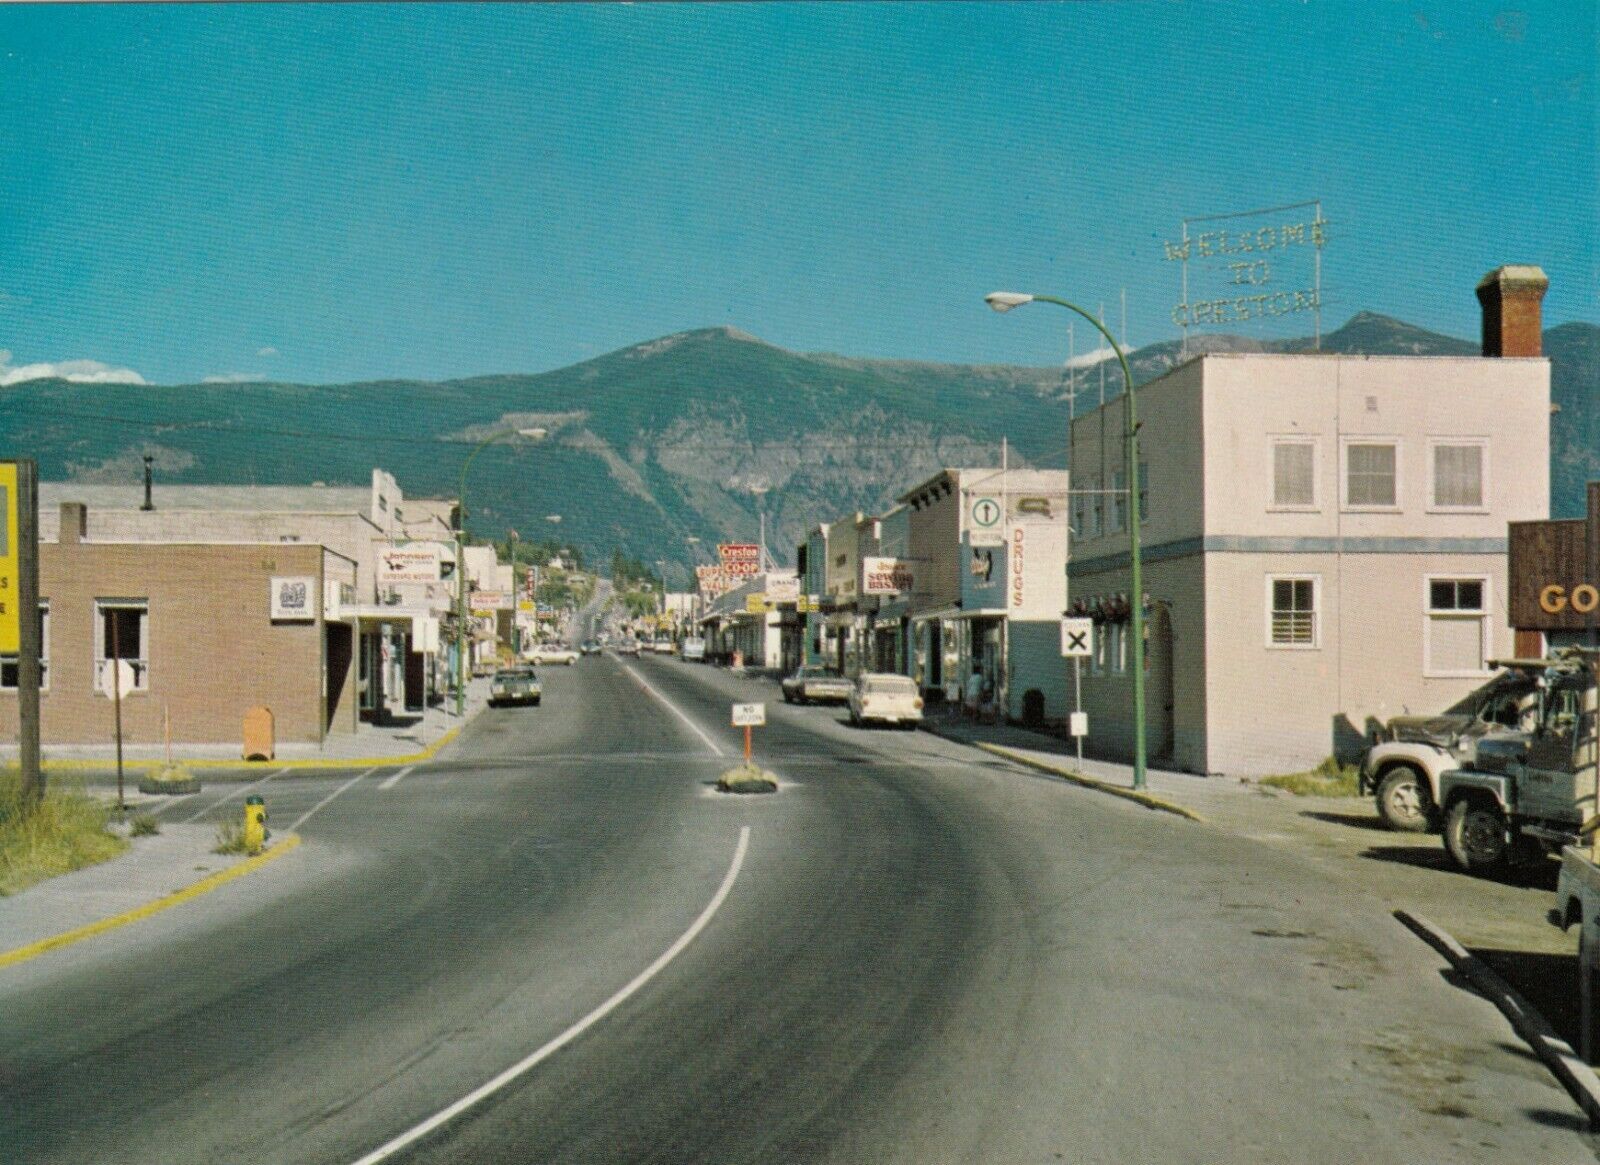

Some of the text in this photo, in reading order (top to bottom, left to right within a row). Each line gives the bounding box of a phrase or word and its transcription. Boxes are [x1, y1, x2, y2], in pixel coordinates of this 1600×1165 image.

[1164, 219, 1329, 261] WELCOME
[1229, 259, 1270, 284] TO
[1170, 287, 1321, 327] CRESTON
[1013, 528, 1025, 607] DRUGS
